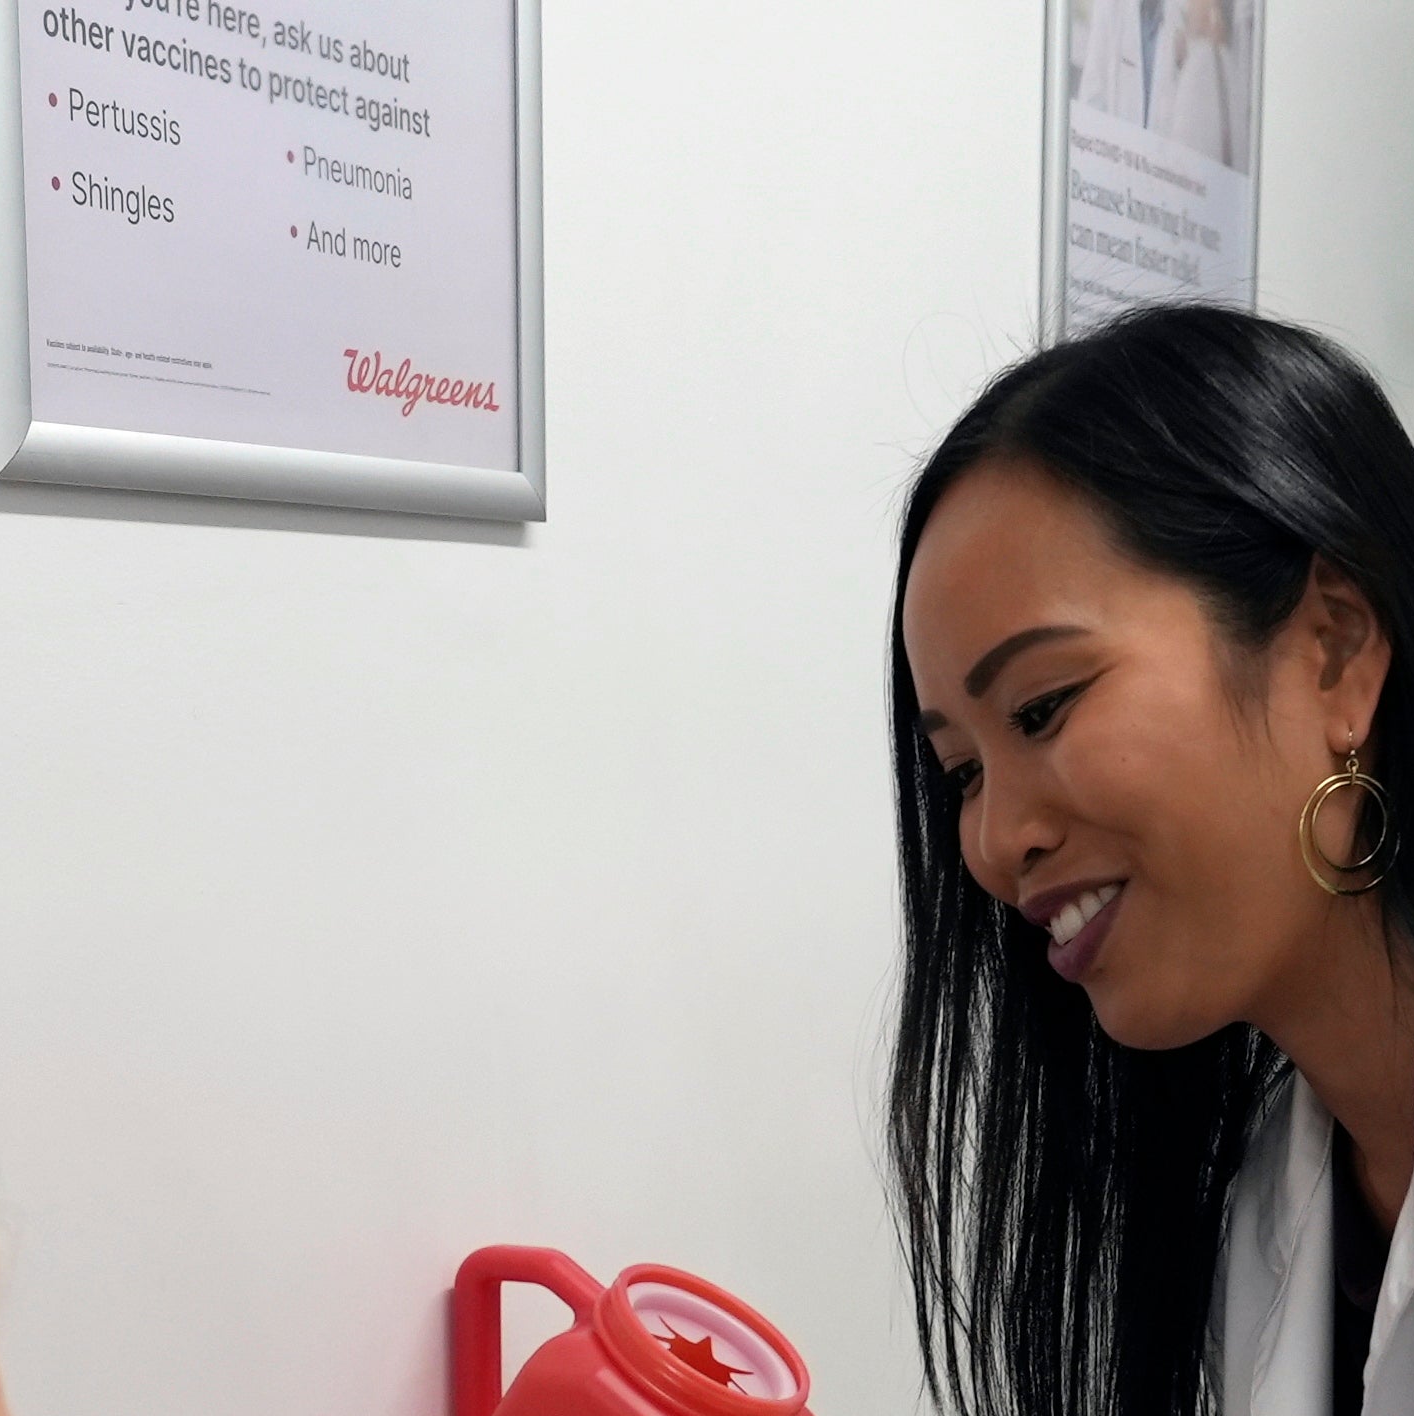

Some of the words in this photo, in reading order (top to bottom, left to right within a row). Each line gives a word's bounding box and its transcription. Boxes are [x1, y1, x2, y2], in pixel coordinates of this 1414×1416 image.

[208, 0, 266, 48] here,
[274, 20, 312, 54] ask
[319, 34, 344, 63] us
[350, 40, 410, 83] about
[43, 8, 114, 52] other
[122, 30, 232, 84] vaccines
[239, 58, 262, 92] to
[269, 70, 349, 115] protect
[355, 98, 431, 137] against
[69, 88, 181, 146] Pertussis
[71, 170, 175, 225] Shingles
[304, 145, 412, 200] Pneumonia
[307, 221, 346, 258] And
[353, 236, 402, 268] more
[343, 349, 500, 417] Walgreens
